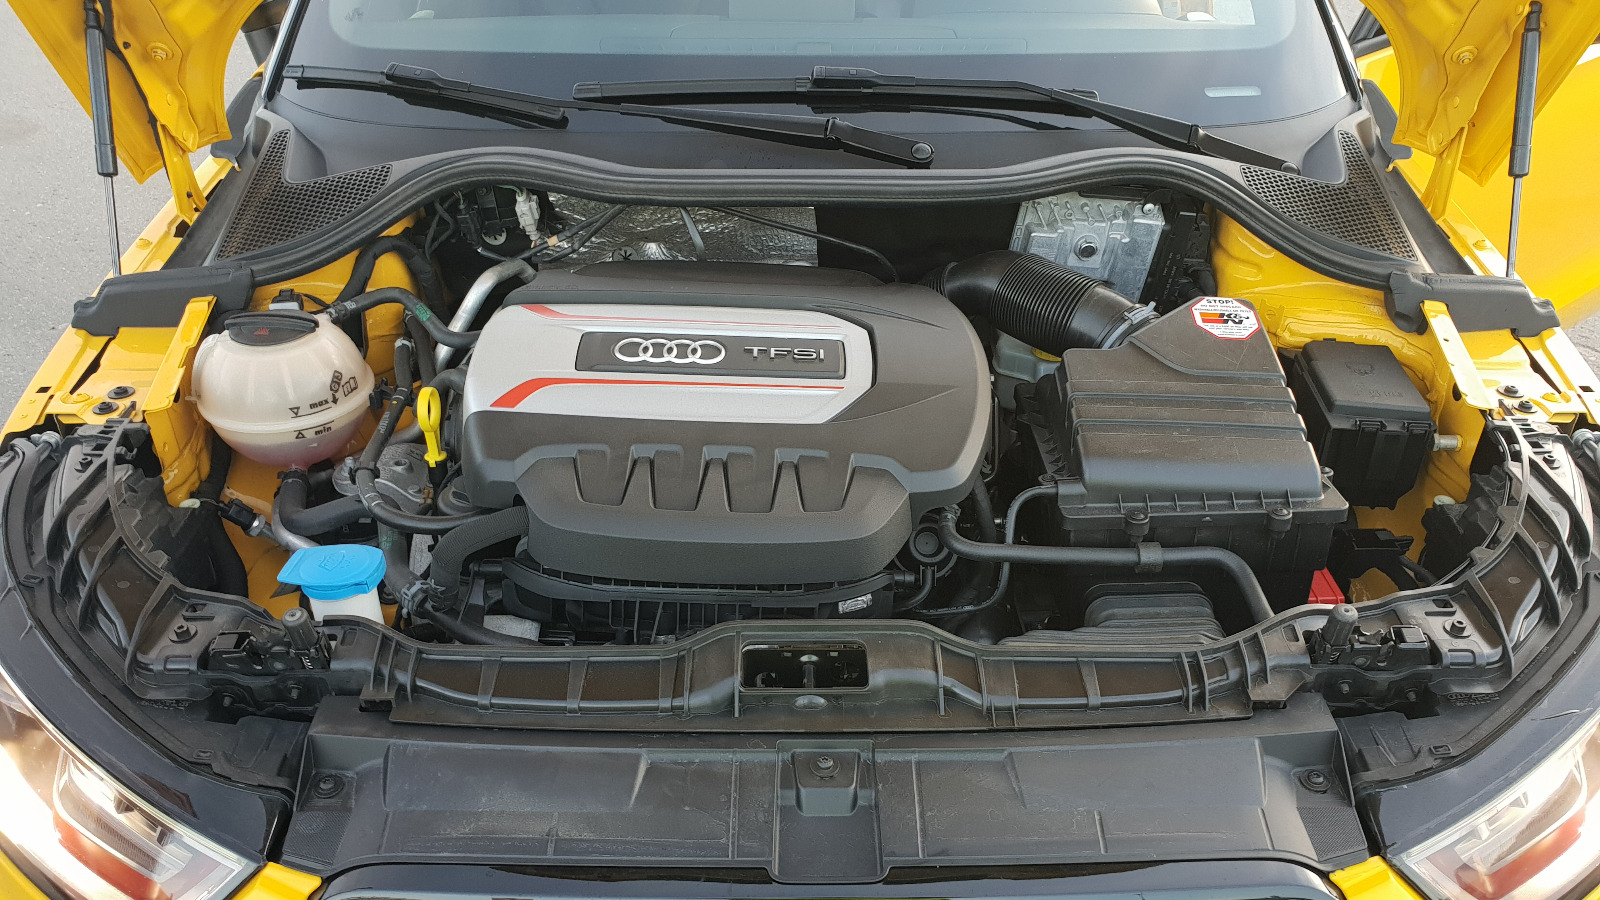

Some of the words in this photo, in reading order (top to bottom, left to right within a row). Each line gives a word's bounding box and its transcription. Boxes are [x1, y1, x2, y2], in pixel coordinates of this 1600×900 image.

[1218, 313, 1249, 325] K&N
[744, 346, 825, 361] TFSI
[309, 399, 330, 409] max
[315, 426, 332, 435] min
